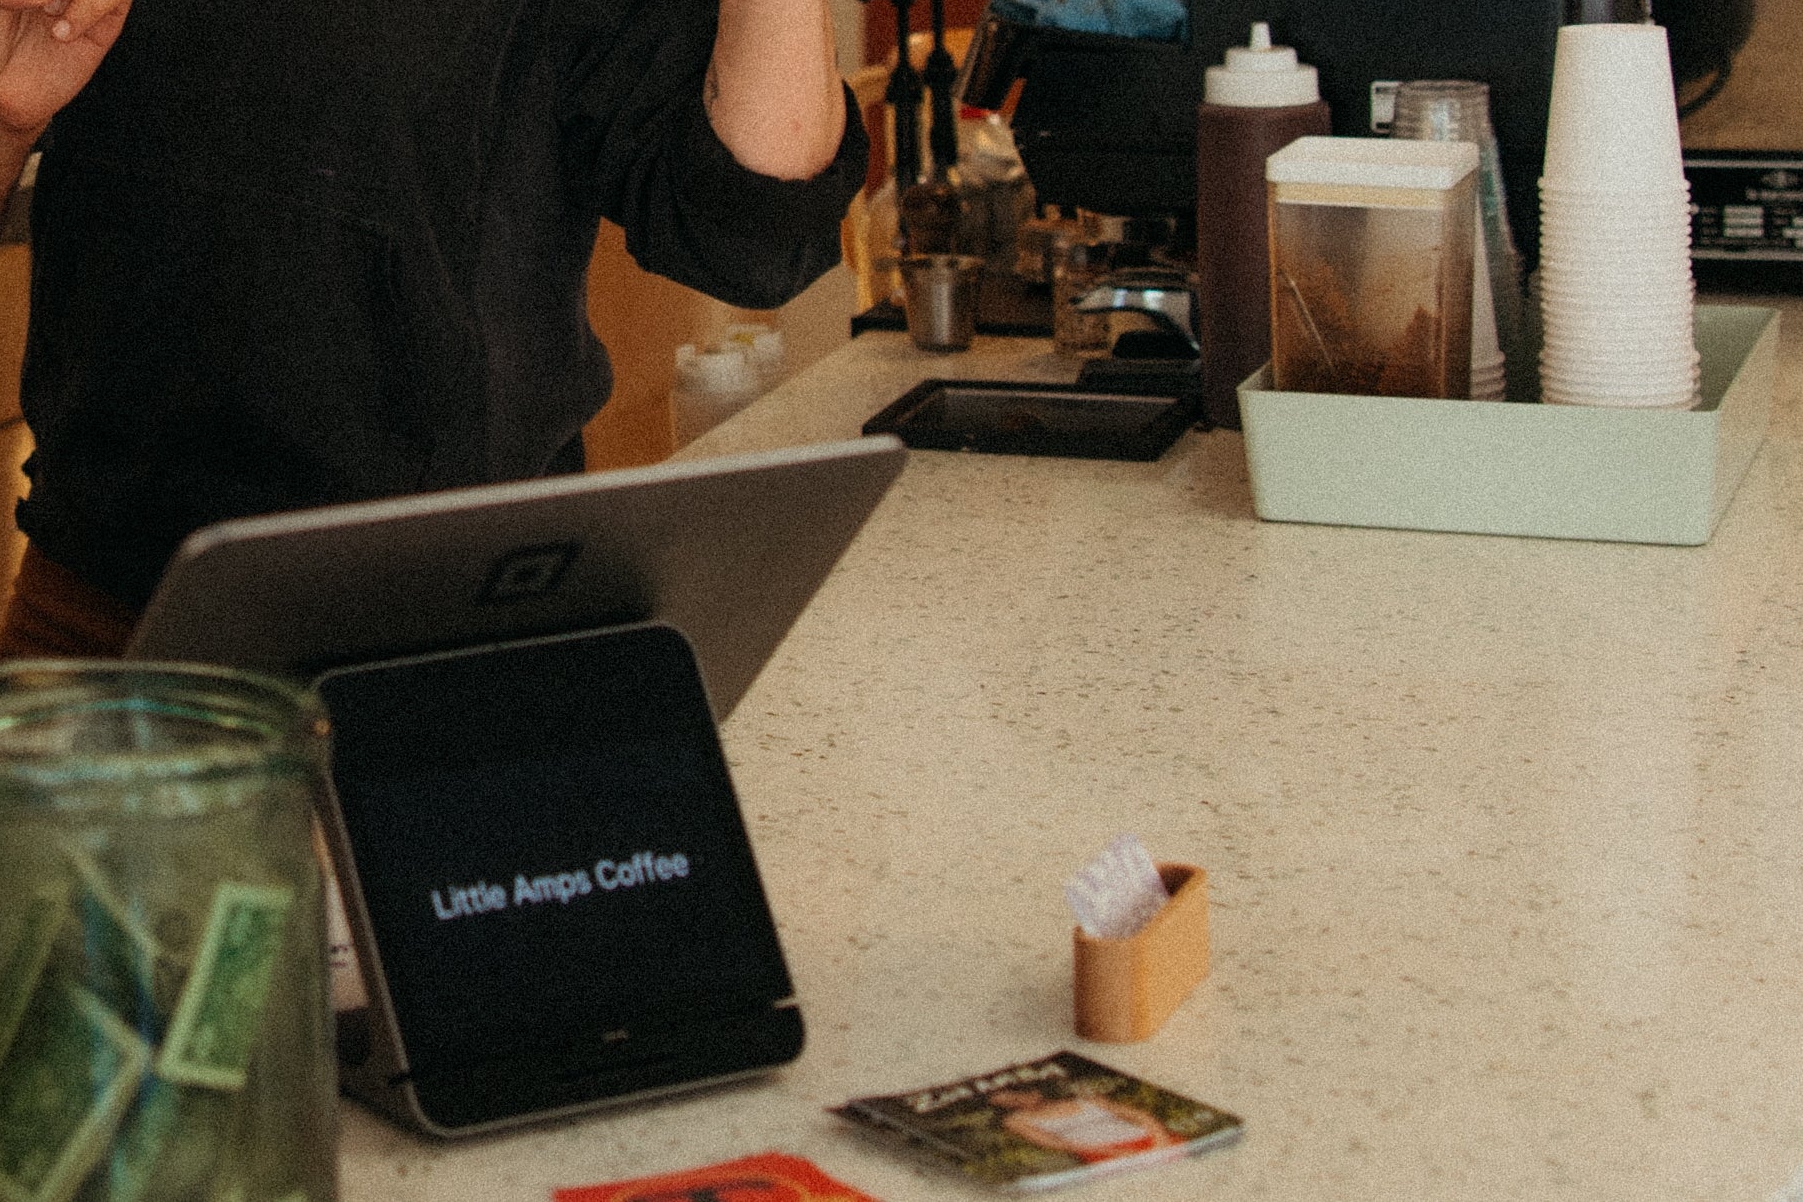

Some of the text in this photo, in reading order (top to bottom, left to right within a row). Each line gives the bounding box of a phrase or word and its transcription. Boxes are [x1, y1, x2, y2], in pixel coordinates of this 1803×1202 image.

[431, 850, 690, 920] Little Amps Coffee
